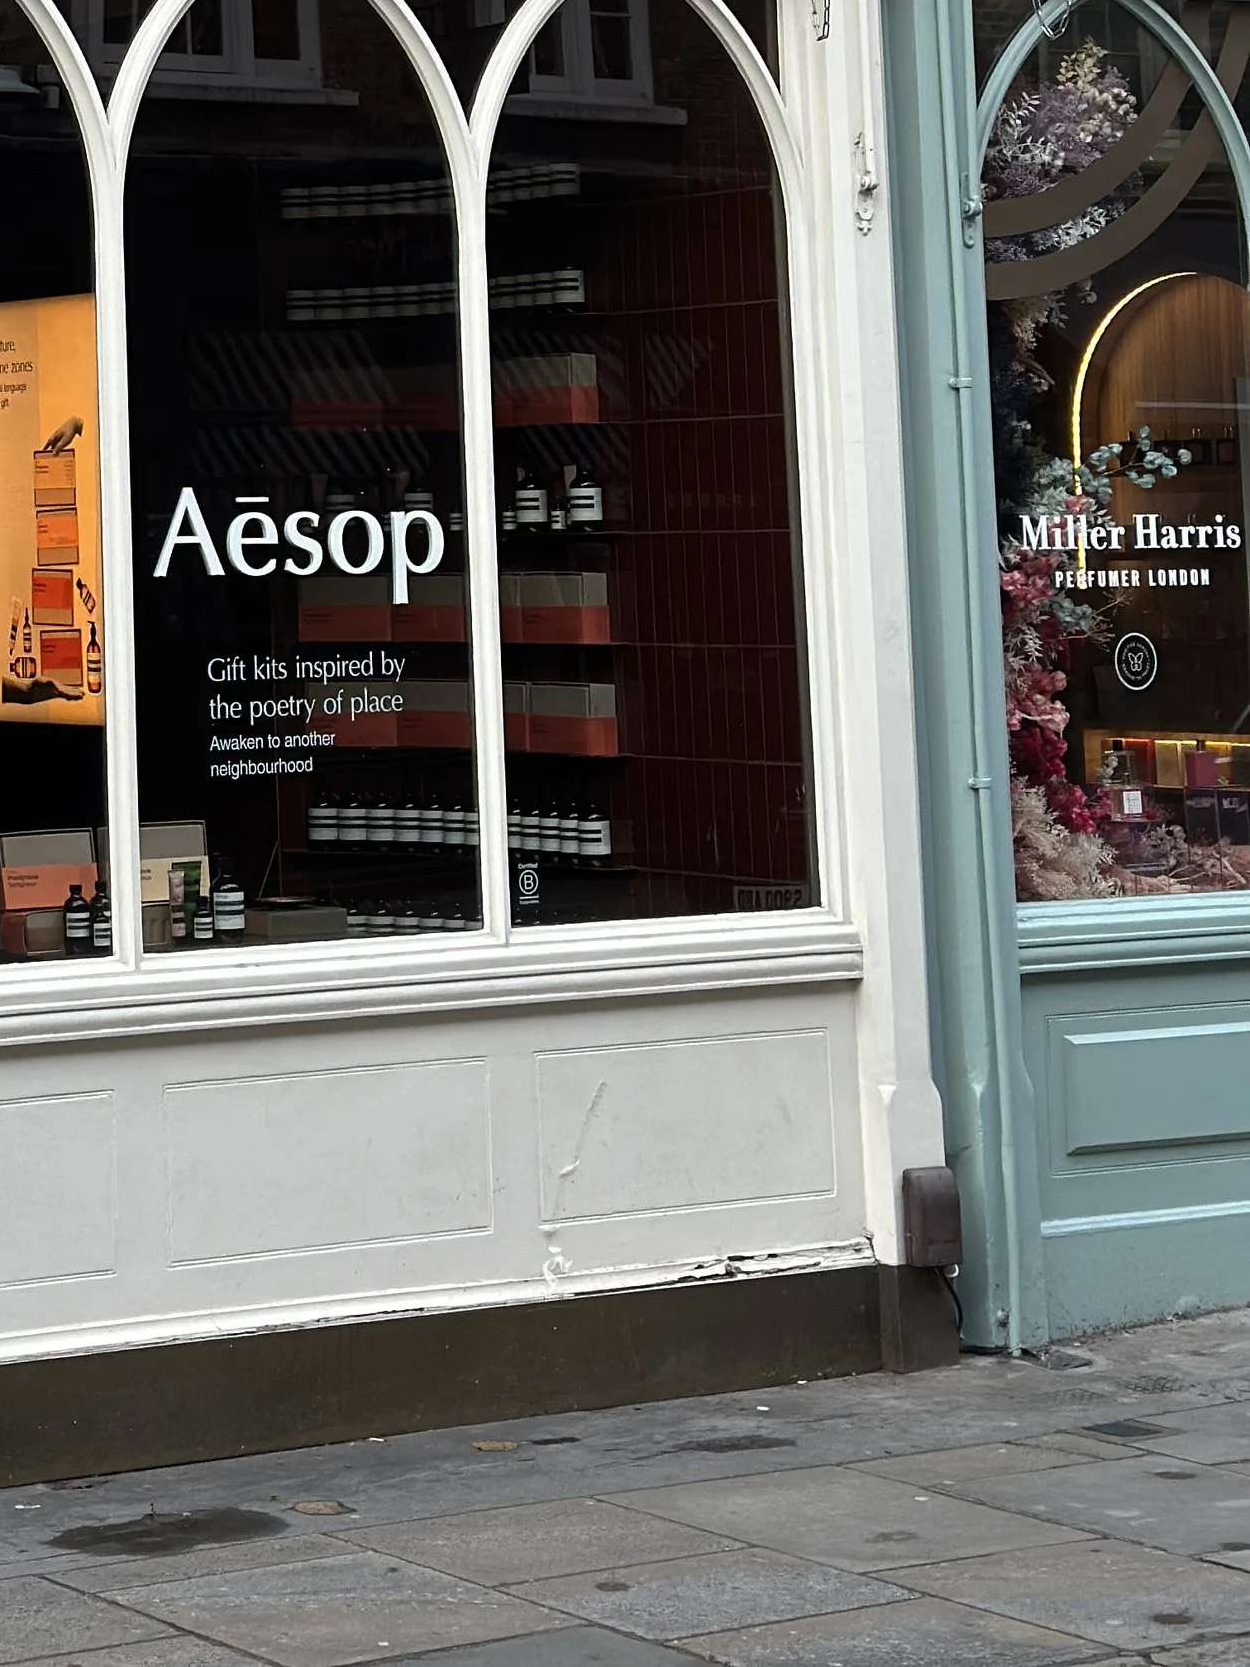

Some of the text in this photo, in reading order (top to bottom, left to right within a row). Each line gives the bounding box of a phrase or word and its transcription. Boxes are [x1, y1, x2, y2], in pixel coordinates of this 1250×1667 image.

[11, 361, 34, 373] zones
[153, 486, 445, 605] Aēsop
[1018, 513, 1242, 551] Miller Harris
[1055, 568, 1211, 589] PERFUMER LONDON
[207, 650, 406, 685] Gift kits inspired by
[209, 687, 404, 725] the poetry of place
[210, 731, 336, 751] Awaken to another
[210, 756, 314, 780] neighbourhood
